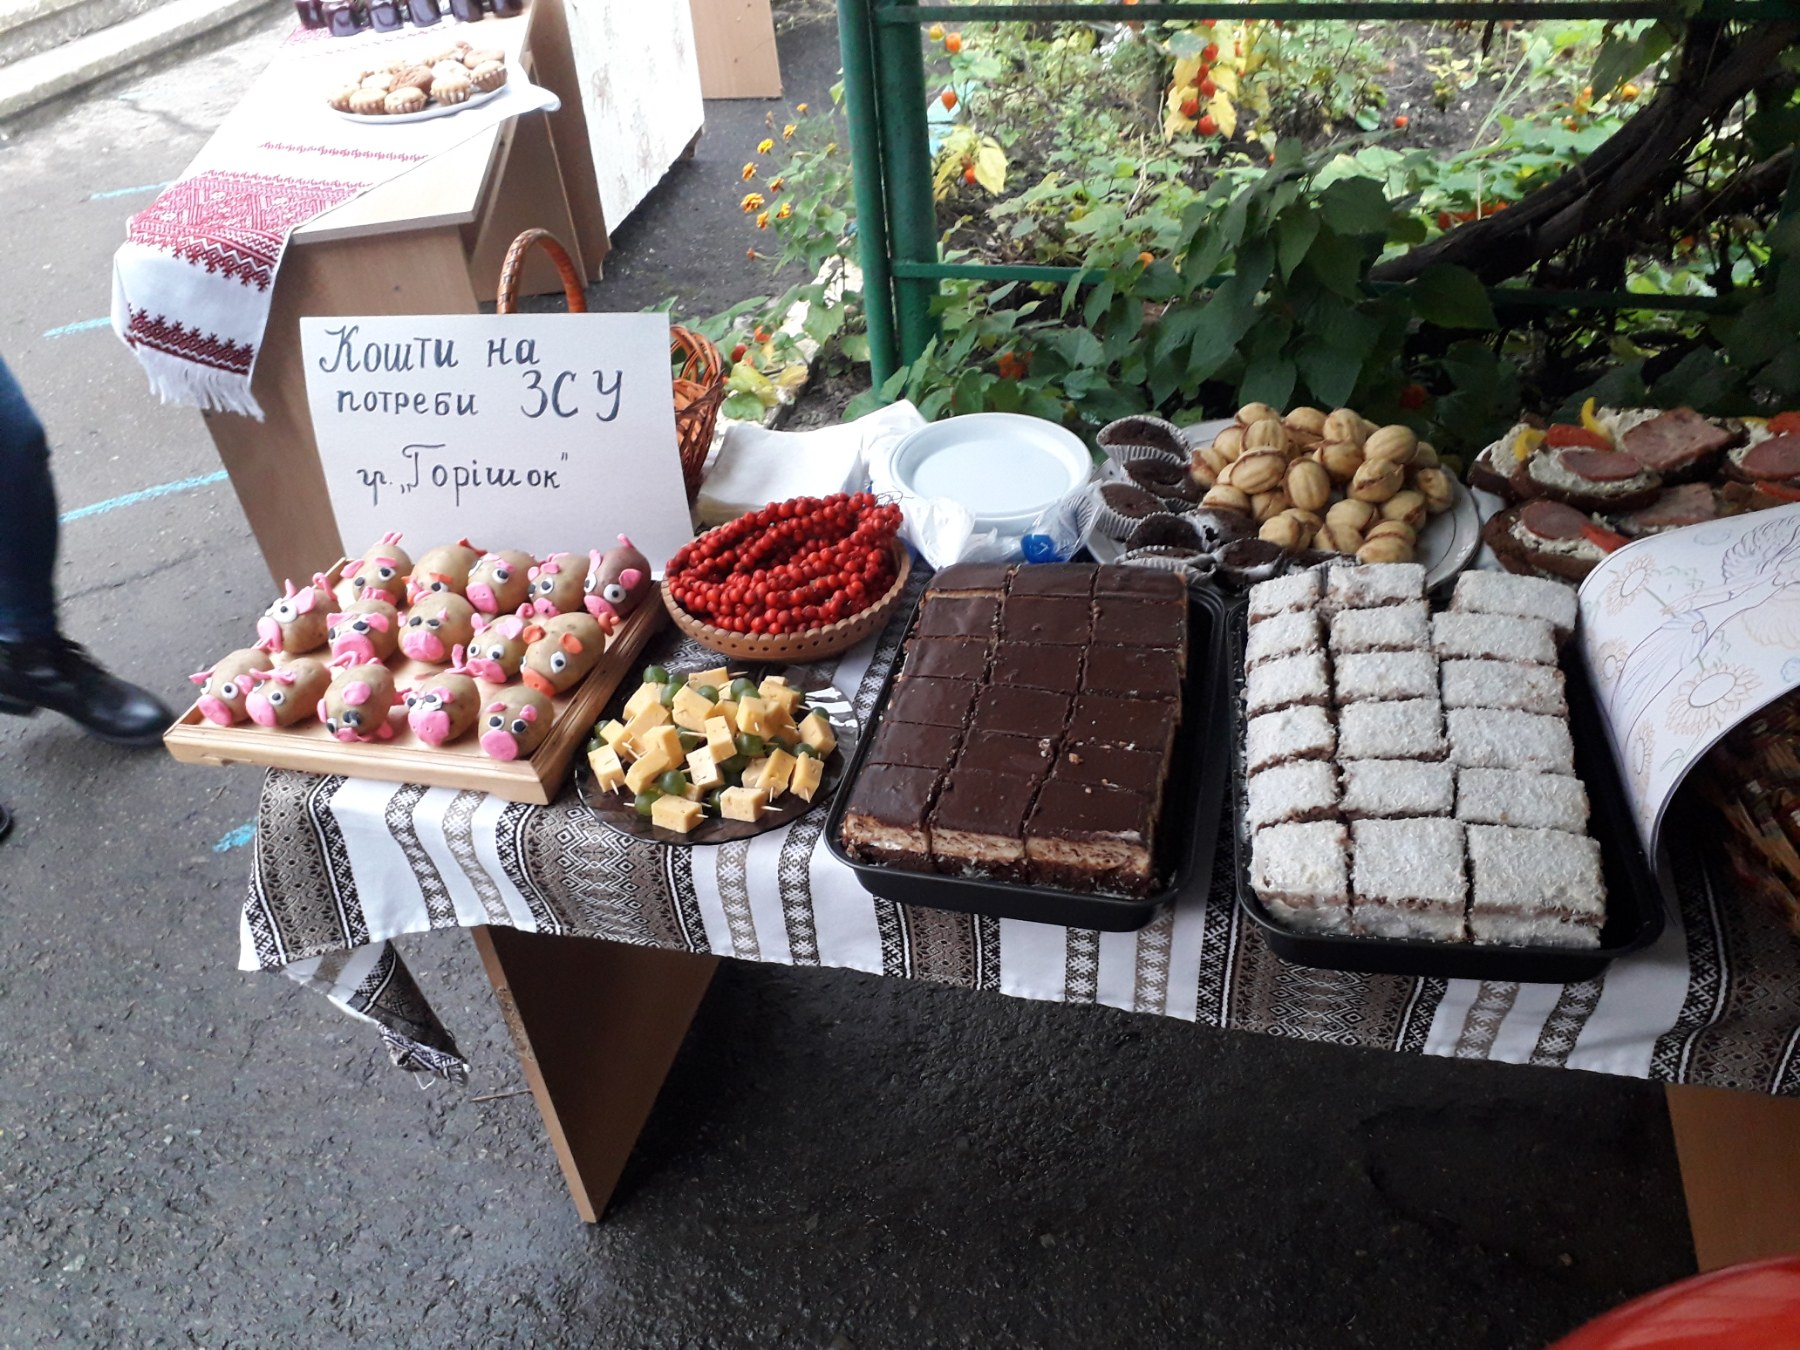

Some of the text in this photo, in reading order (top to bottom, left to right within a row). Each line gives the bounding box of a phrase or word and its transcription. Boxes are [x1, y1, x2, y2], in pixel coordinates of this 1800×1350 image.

[319, 325, 540, 373] Кошти на
[337, 369, 623, 422] потреби ЗСУ
